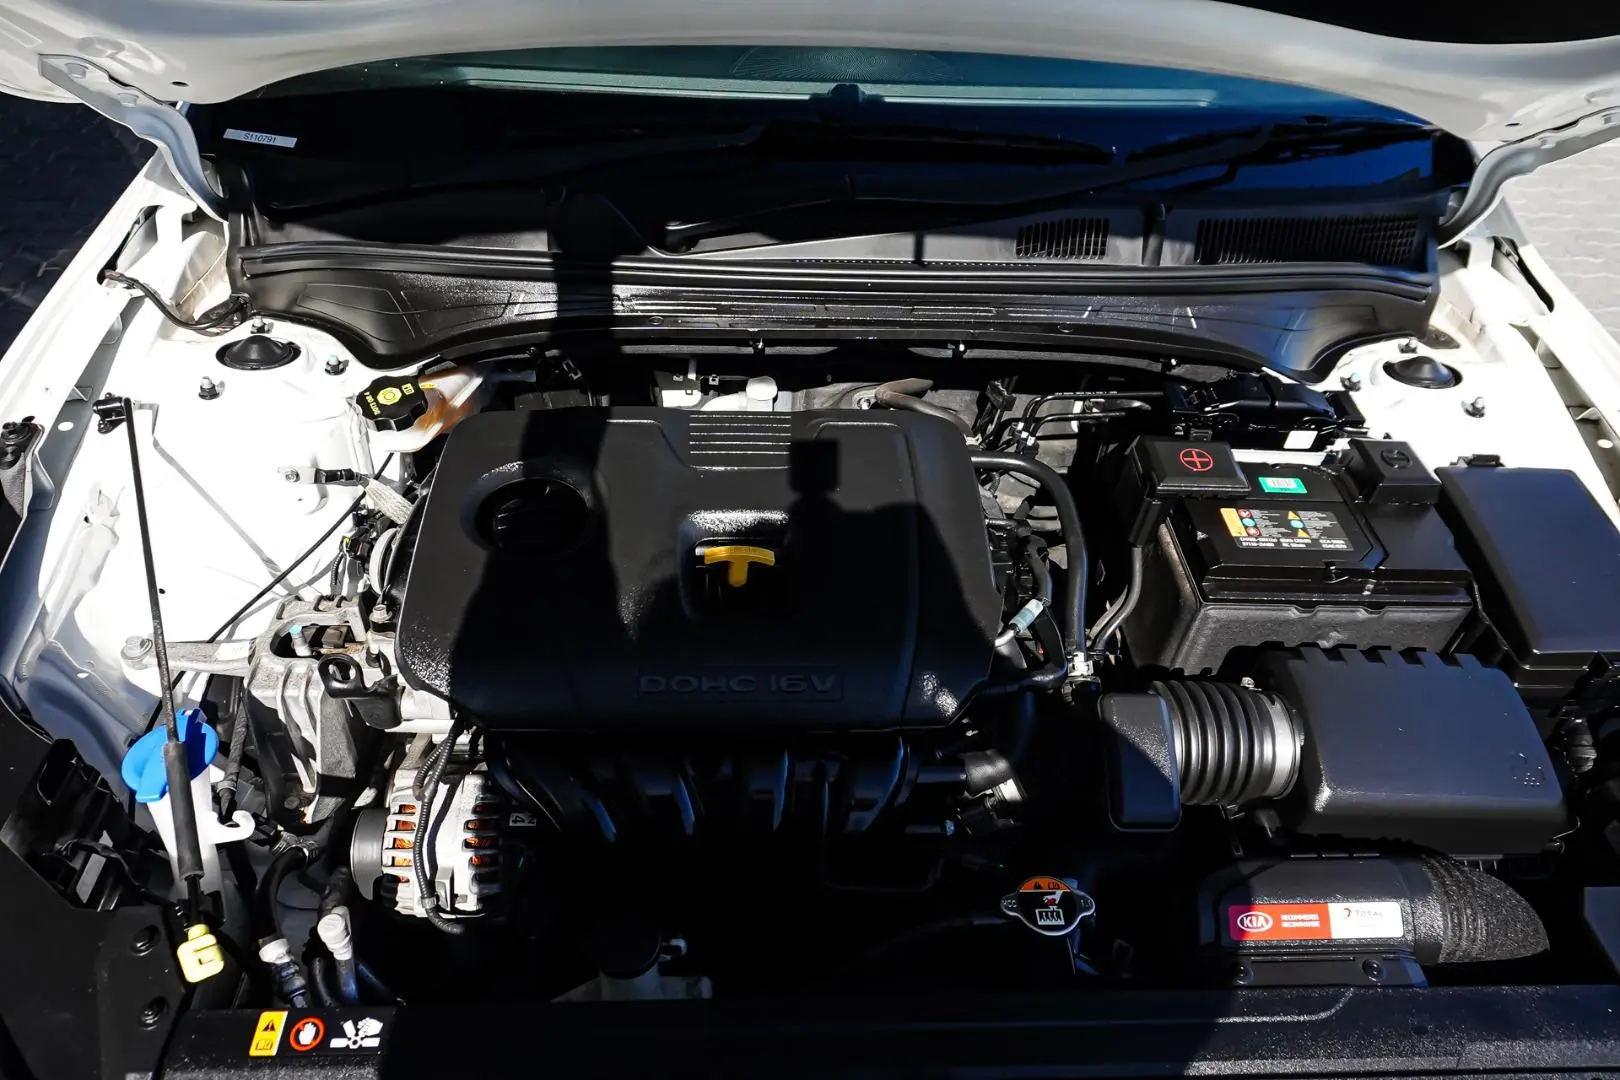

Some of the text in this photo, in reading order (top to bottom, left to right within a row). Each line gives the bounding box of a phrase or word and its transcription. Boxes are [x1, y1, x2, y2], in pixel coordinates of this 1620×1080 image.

[243, 132, 276, 143] S110791
[639, 673, 836, 693] DOHC 16V
[1355, 909, 1384, 918] TOTAL
